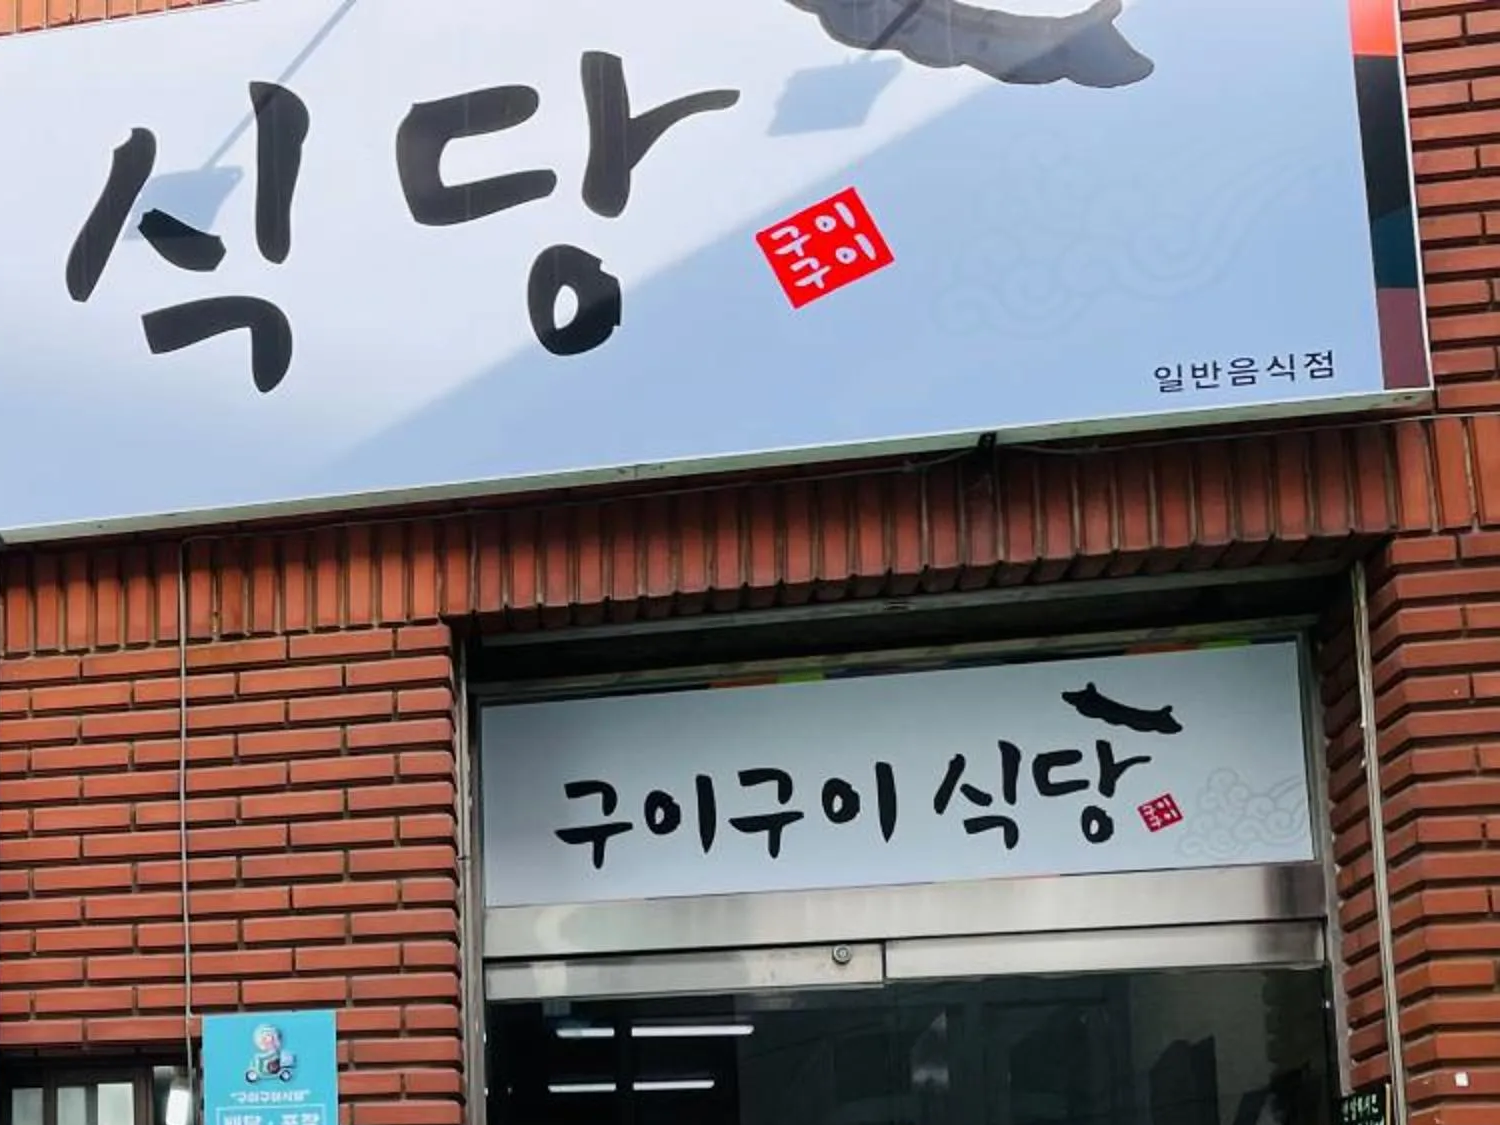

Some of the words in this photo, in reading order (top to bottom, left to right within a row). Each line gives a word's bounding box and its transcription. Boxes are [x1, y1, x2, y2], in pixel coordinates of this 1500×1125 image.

[64, 50, 740, 394] 식당
[769, 201, 857, 258] 구이
[789, 232, 877, 290] 구이
[1153, 350, 1334, 393] 일반음식점
[554, 761, 897, 870] 구이구이
[934, 740, 1152, 851] 식당
